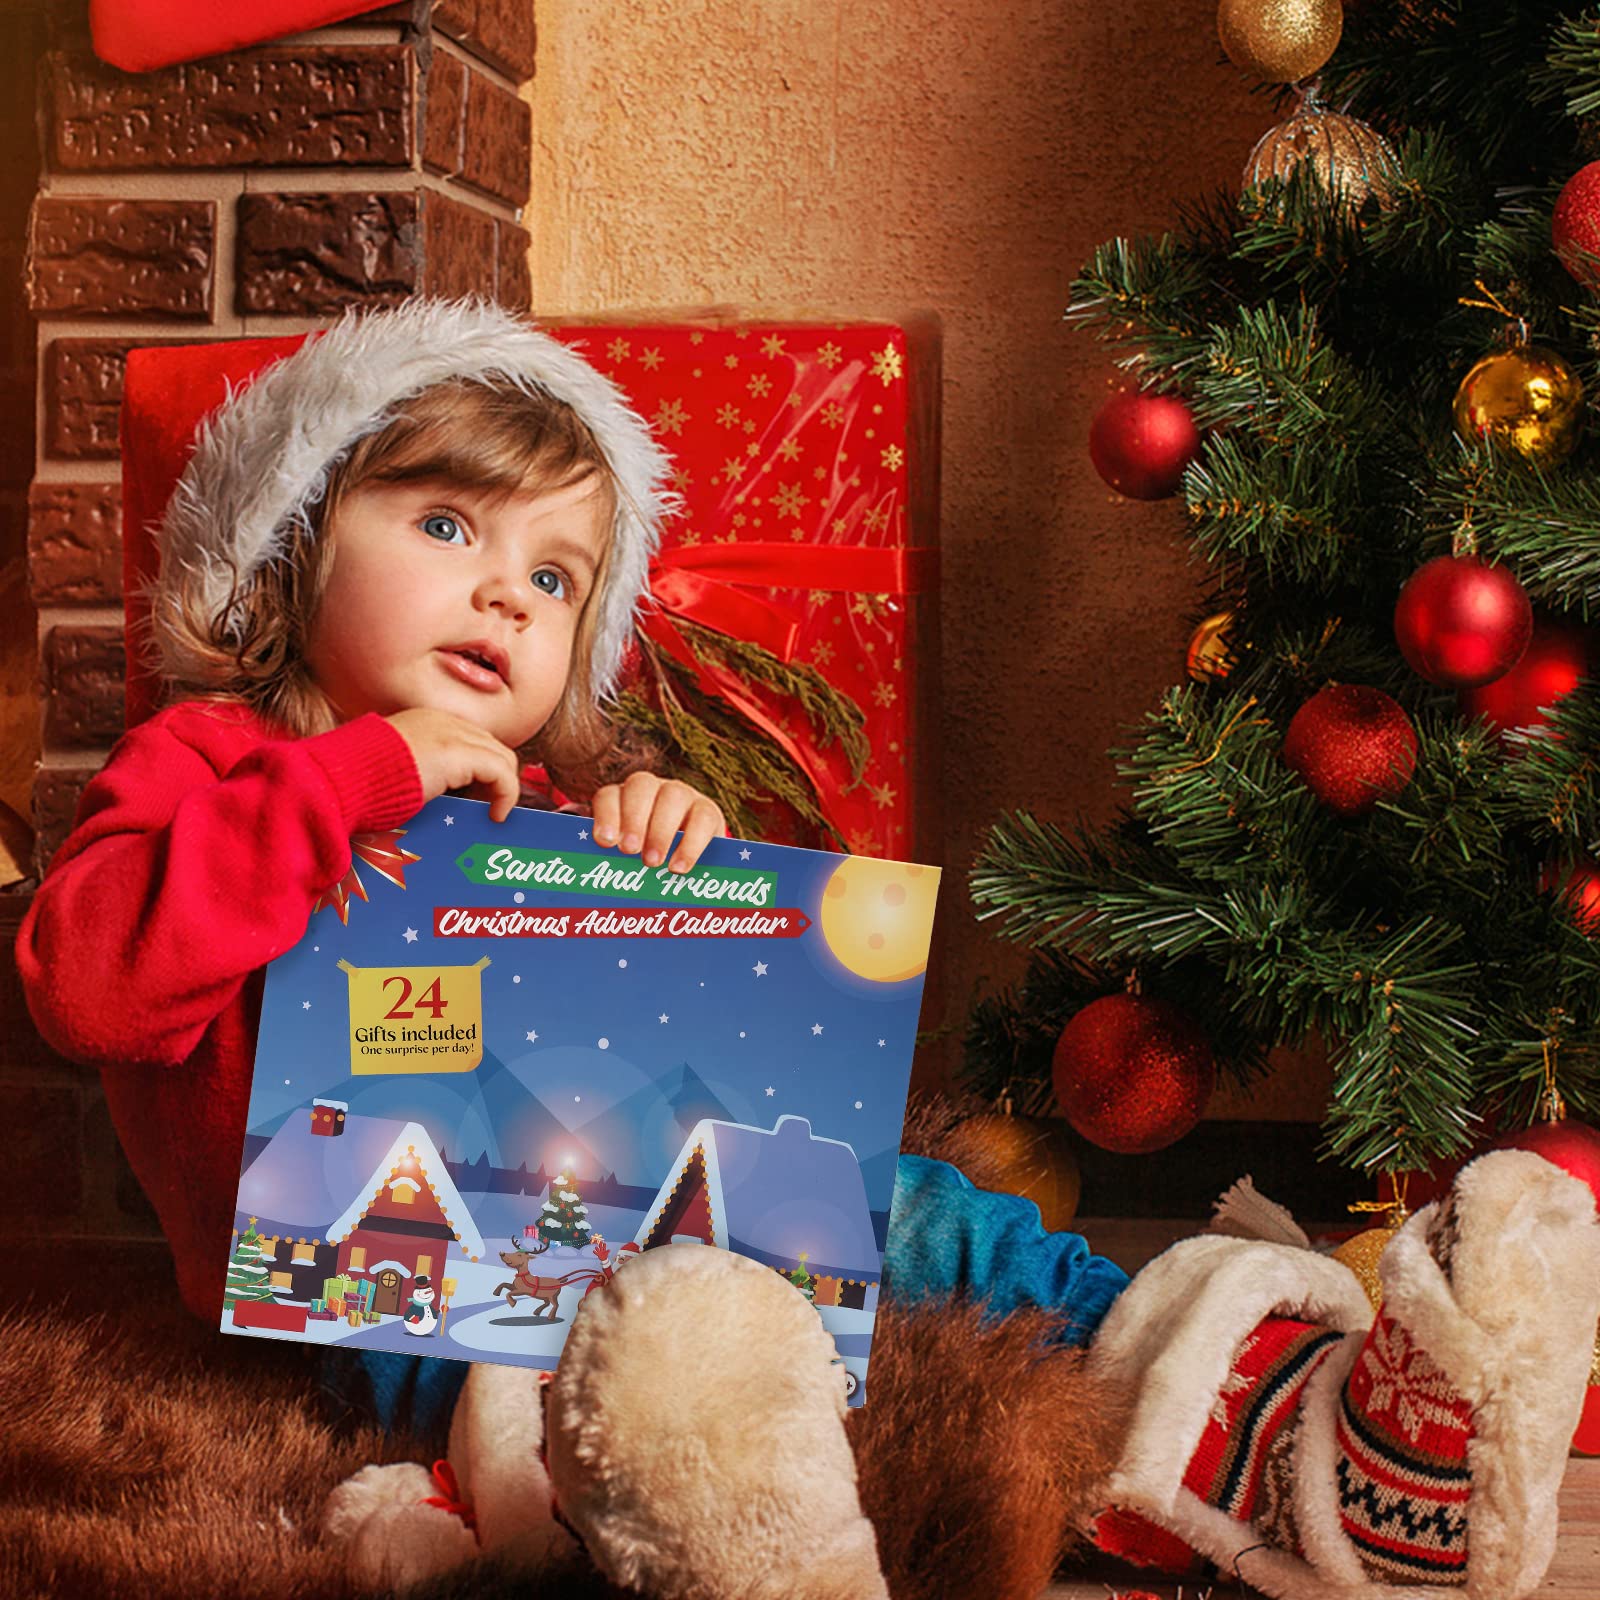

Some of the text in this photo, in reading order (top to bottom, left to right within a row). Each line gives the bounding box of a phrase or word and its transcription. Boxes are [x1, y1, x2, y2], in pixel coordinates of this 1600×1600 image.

[484, 848, 772, 906] Santa And Friends
[438, 908, 788, 936] Christmas Advent Calendar
[382, 975, 449, 1020] 24
[355, 1022, 477, 1043] Gifts included
[360, 1042, 475, 1057] One surprise per day!
